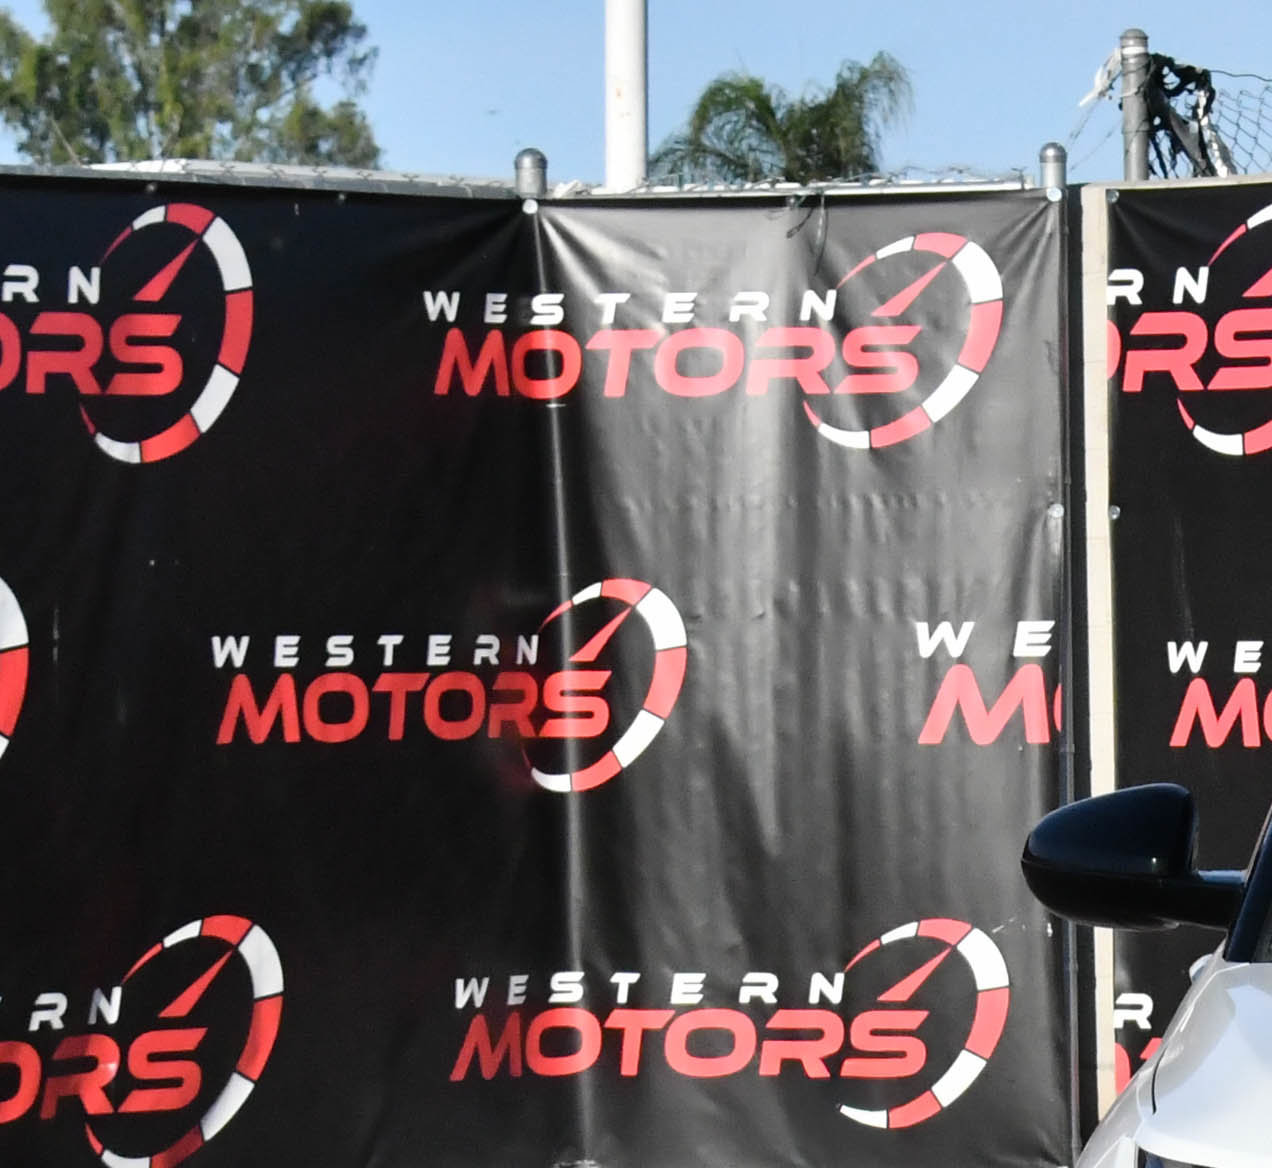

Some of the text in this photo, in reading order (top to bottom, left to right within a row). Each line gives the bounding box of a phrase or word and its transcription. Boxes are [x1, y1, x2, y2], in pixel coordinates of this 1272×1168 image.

[425, 288, 837, 323] WESTERN
[0, 312, 183, 396] RS
[434, 325, 921, 400] MOTORS
[212, 635, 538, 667] WESTERN
[216, 670, 612, 744] MOTORS
[918, 664, 1062, 746] M
[455, 971, 846, 1006] WESTERN
[450, 1006, 929, 1081] MOTORS
